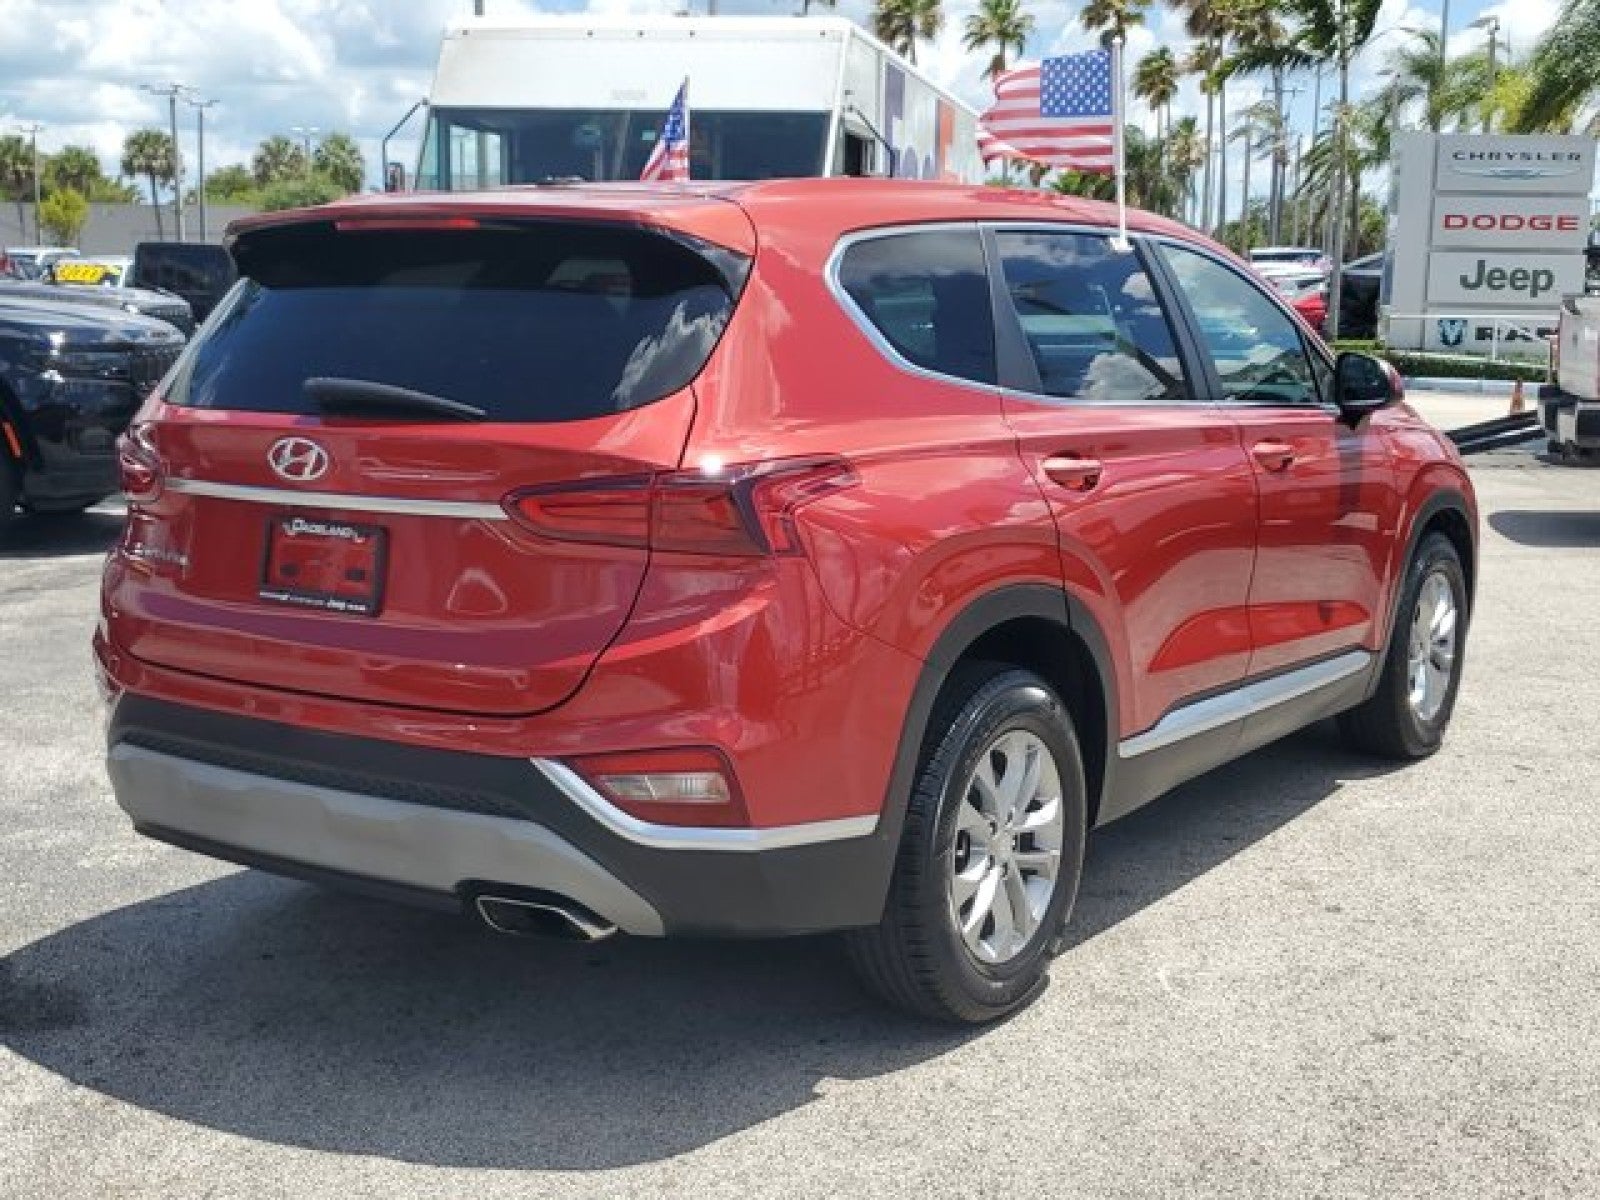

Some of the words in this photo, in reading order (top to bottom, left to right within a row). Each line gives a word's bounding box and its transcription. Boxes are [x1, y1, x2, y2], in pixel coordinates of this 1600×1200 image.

[1452, 151, 1582, 162] CHRYSLER
[1443, 213, 1581, 231] DODGE
[1459, 258, 1556, 298] Jeep
